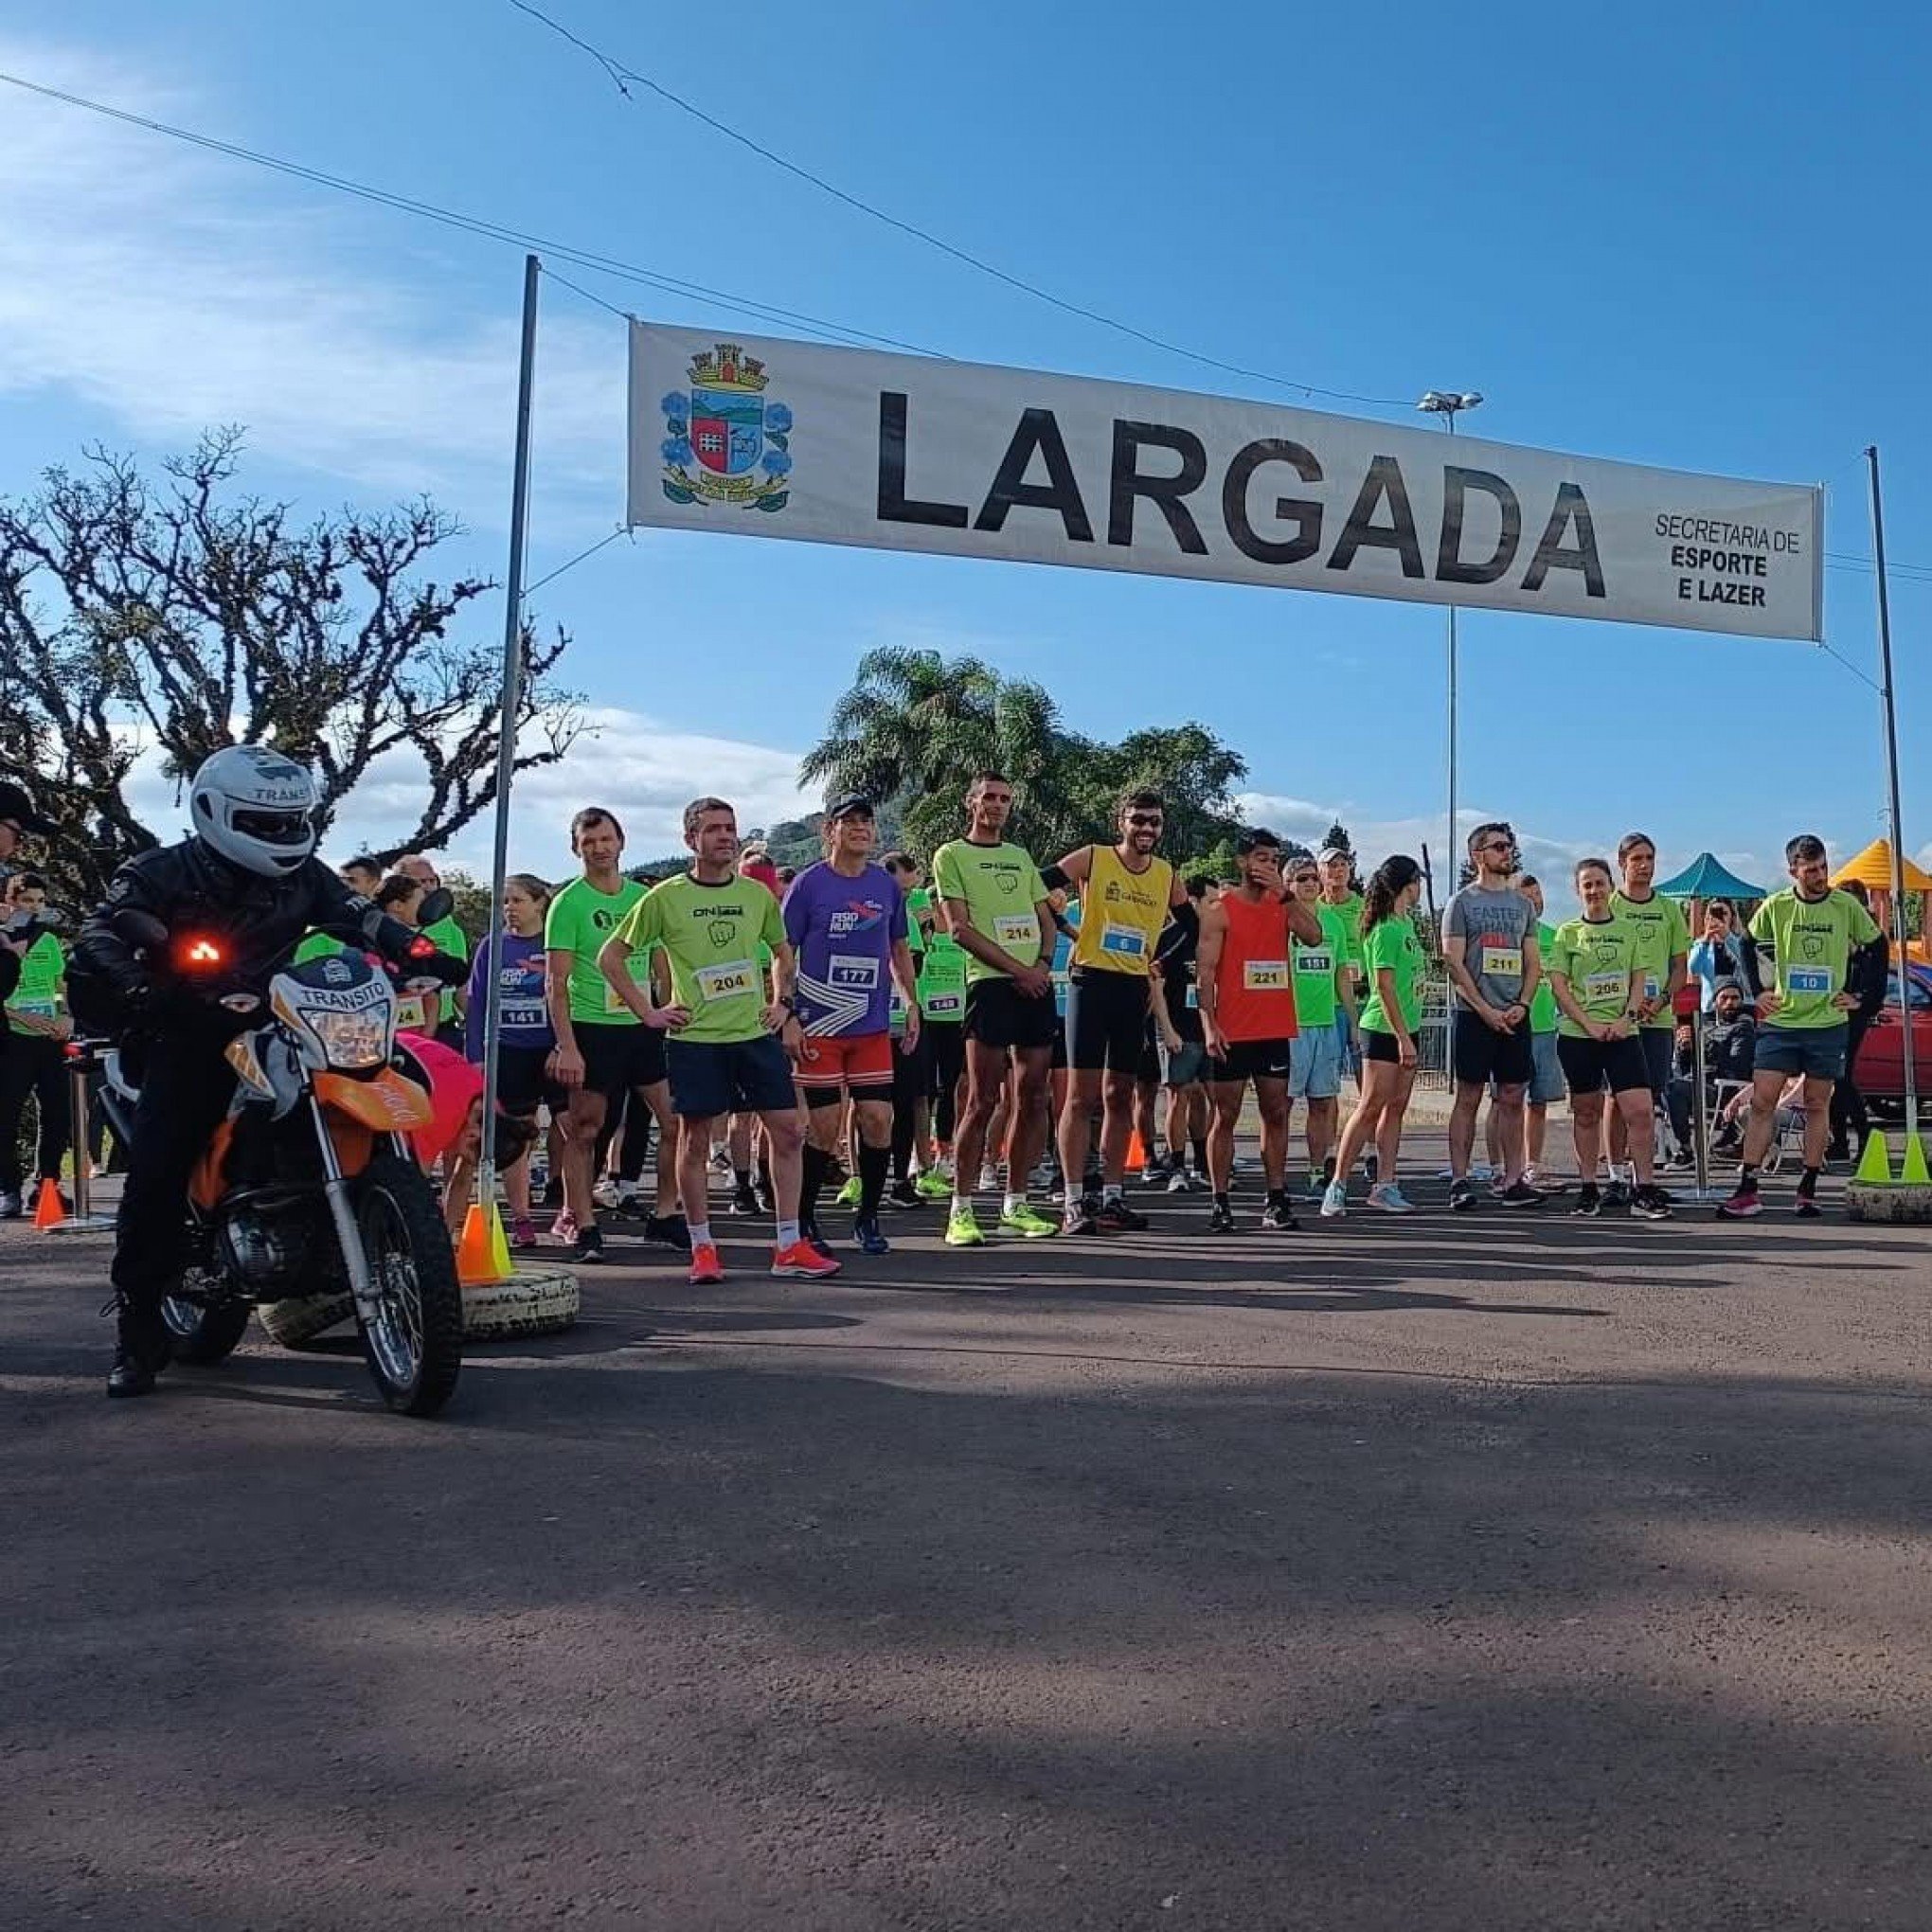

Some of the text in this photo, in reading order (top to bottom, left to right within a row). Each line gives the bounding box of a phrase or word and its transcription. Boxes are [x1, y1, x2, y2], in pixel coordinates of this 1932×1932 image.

[876, 390, 1607, 599] LARGADA
[1655, 513, 1799, 554] SECRETARIA DE
[1671, 546, 1767, 577] ESPORTE
[1678, 577, 1767, 607] E LAZER
[1006, 928, 1030, 939] 214
[1492, 958, 1513, 970] 211
[839, 970, 870, 982] 177
[1252, 972, 1278, 984] 221
[1800, 976, 1816, 988] 10
[713, 975, 744, 992] 204
[508, 1011, 535, 1023] 141
